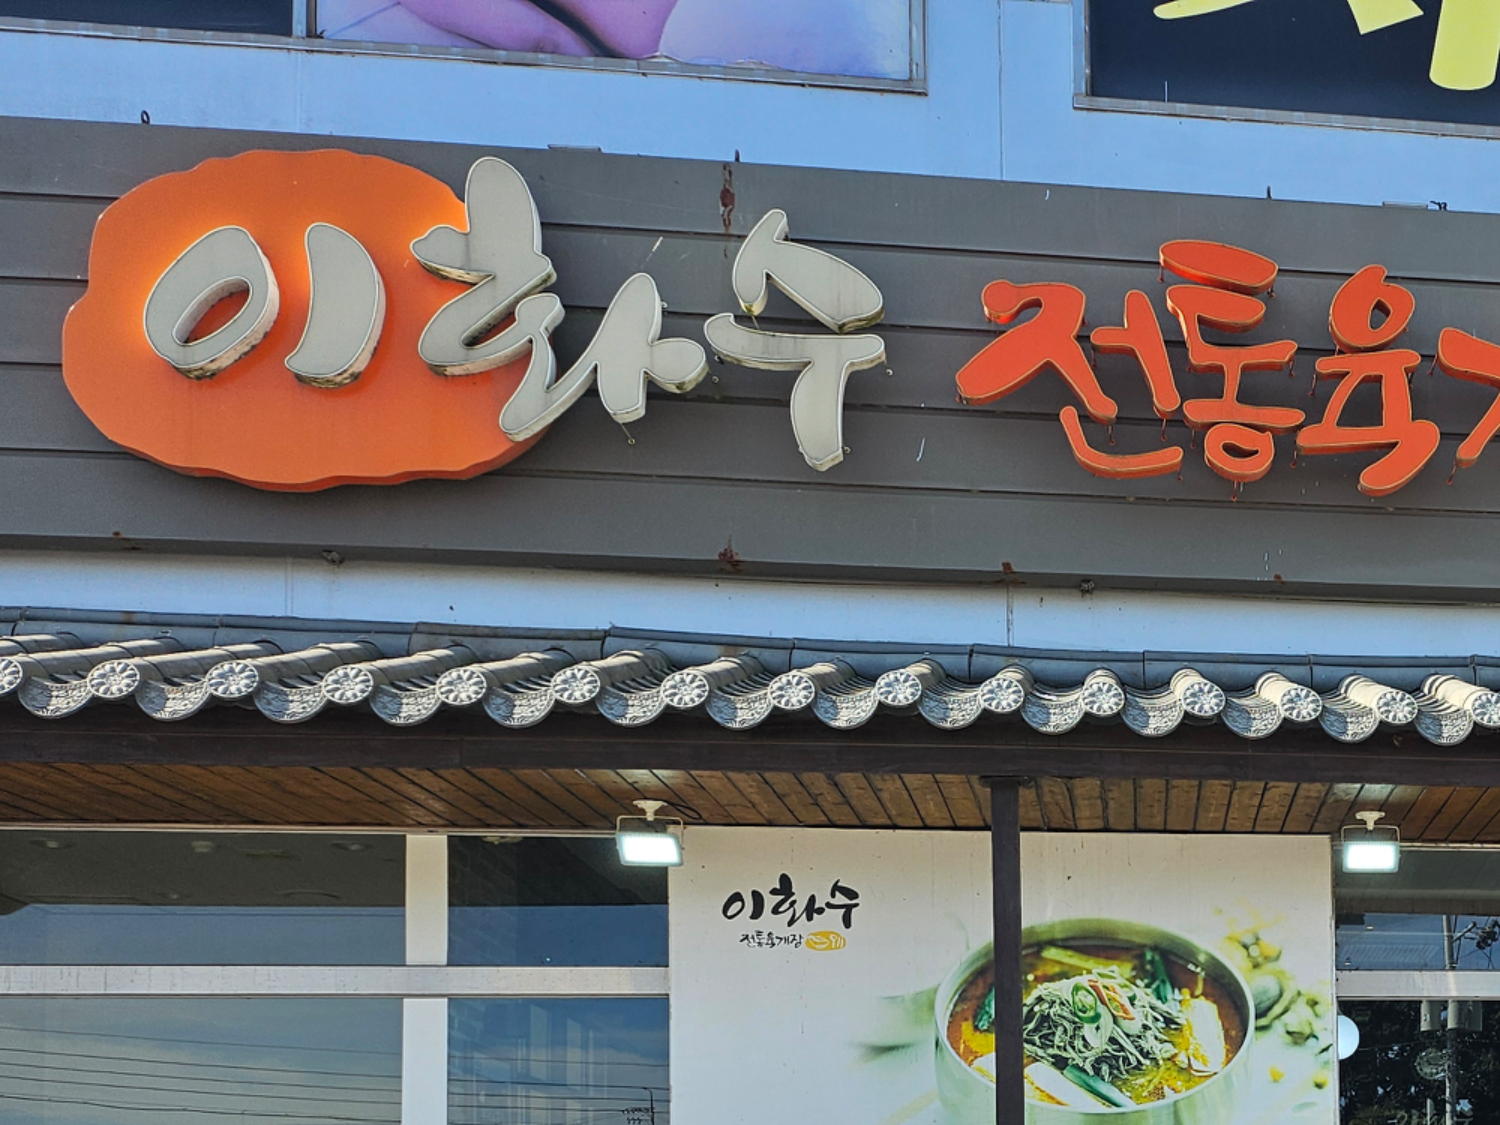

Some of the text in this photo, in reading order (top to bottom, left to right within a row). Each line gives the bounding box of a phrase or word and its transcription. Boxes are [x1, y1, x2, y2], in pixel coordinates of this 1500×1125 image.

[144, 156, 887, 471] 이화수
[722, 873, 860, 929] 이화수
[739, 930, 804, 949] 전통육개장
